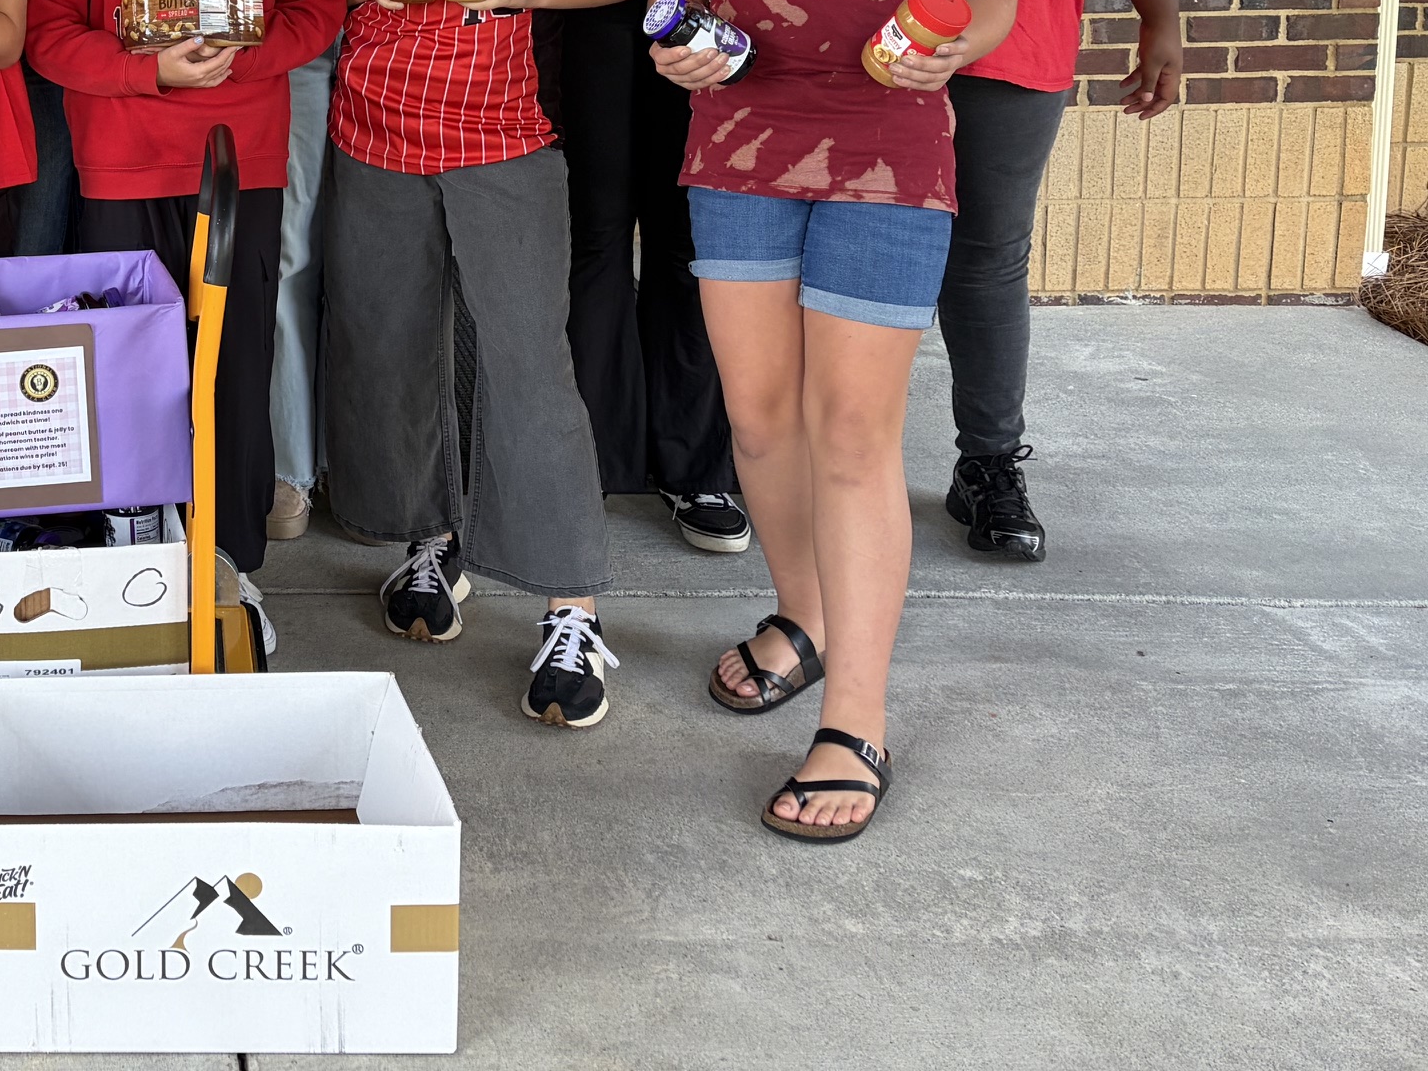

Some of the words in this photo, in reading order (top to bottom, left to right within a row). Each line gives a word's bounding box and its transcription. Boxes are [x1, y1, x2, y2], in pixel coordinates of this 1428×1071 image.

[167, 10, 188, 18] SPREAD
[5, 430, 28, 438] peanut
[54, 426, 67, 434] jelly
[40, 451, 58, 459] prize!
[41, 462, 58, 470] Sept.
[24, 668, 75, 676] 792401
[60, 949, 191, 981] GOLD
